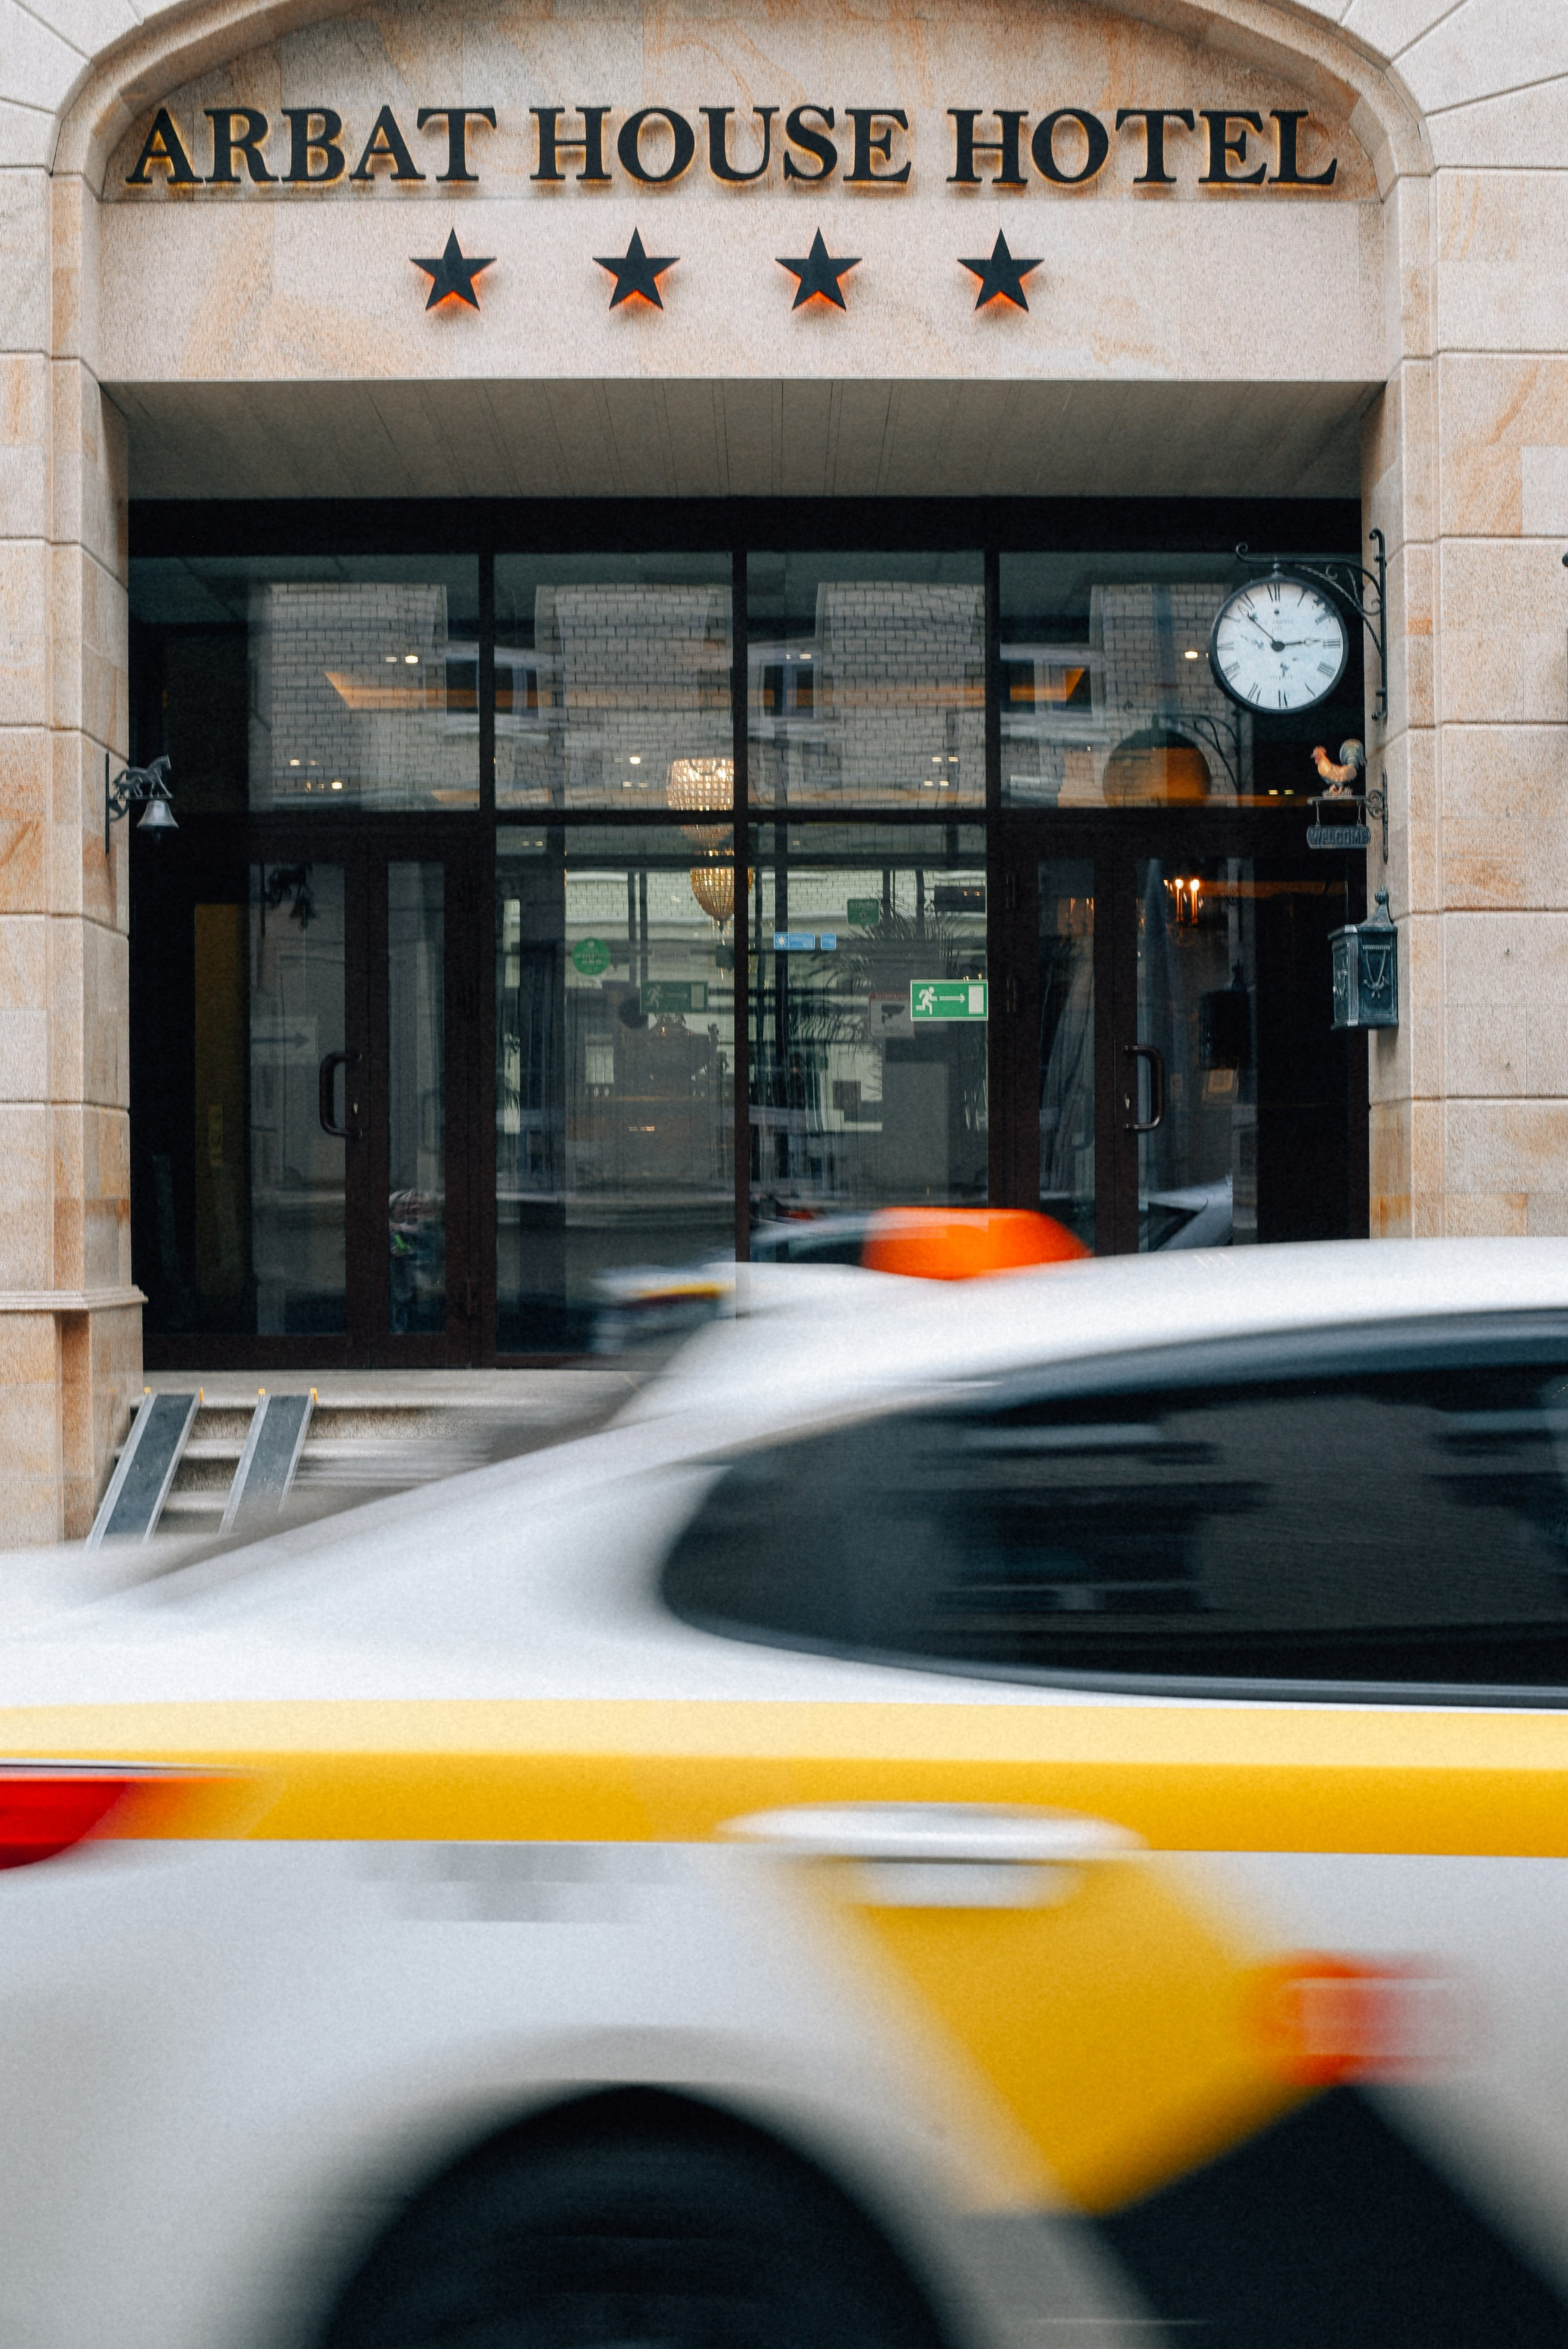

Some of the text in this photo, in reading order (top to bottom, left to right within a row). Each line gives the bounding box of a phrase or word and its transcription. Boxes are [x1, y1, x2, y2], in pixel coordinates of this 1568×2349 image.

[126, 105, 1338, 186] ARBAT HOUSE HOTEL
[1310, 828, 1368, 845] WELCOME
